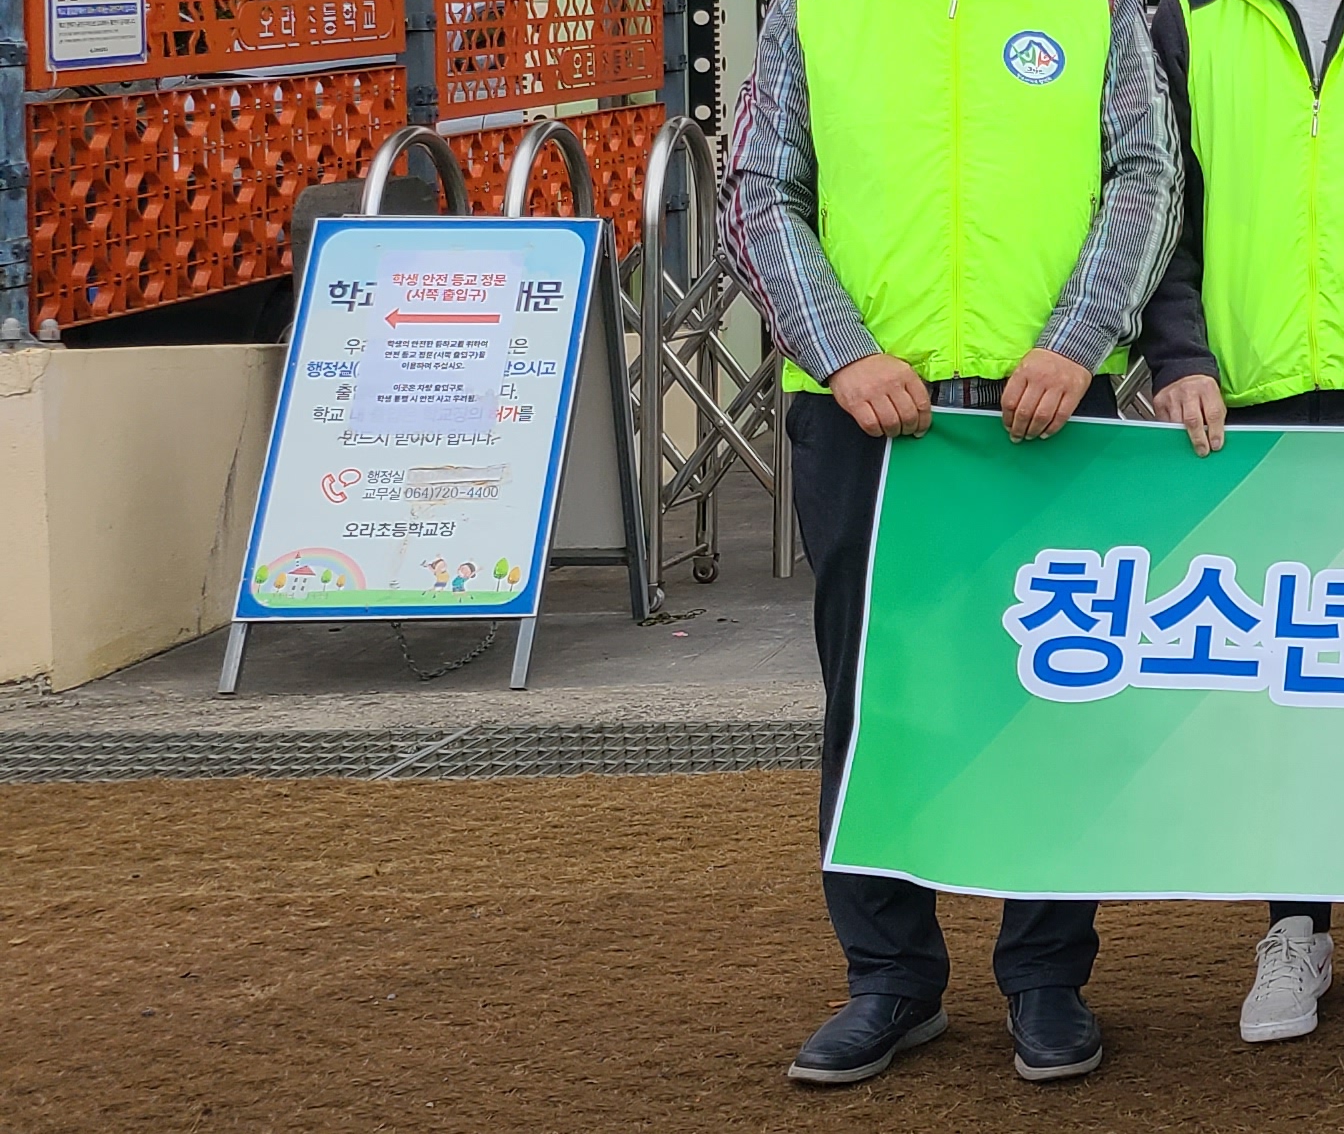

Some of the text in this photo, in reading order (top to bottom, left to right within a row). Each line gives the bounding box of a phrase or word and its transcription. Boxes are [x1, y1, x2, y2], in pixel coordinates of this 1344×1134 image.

[392, 273, 507, 287] 학생 안전 등교 정문
[406, 288, 487, 303] (서쪽 출입구)
[313, 405, 344, 424] 학교
[367, 469, 406, 484] 행정실
[362, 485, 499, 501] 교무실 064)720-4400
[343, 521, 456, 539] 오라초등학교장
